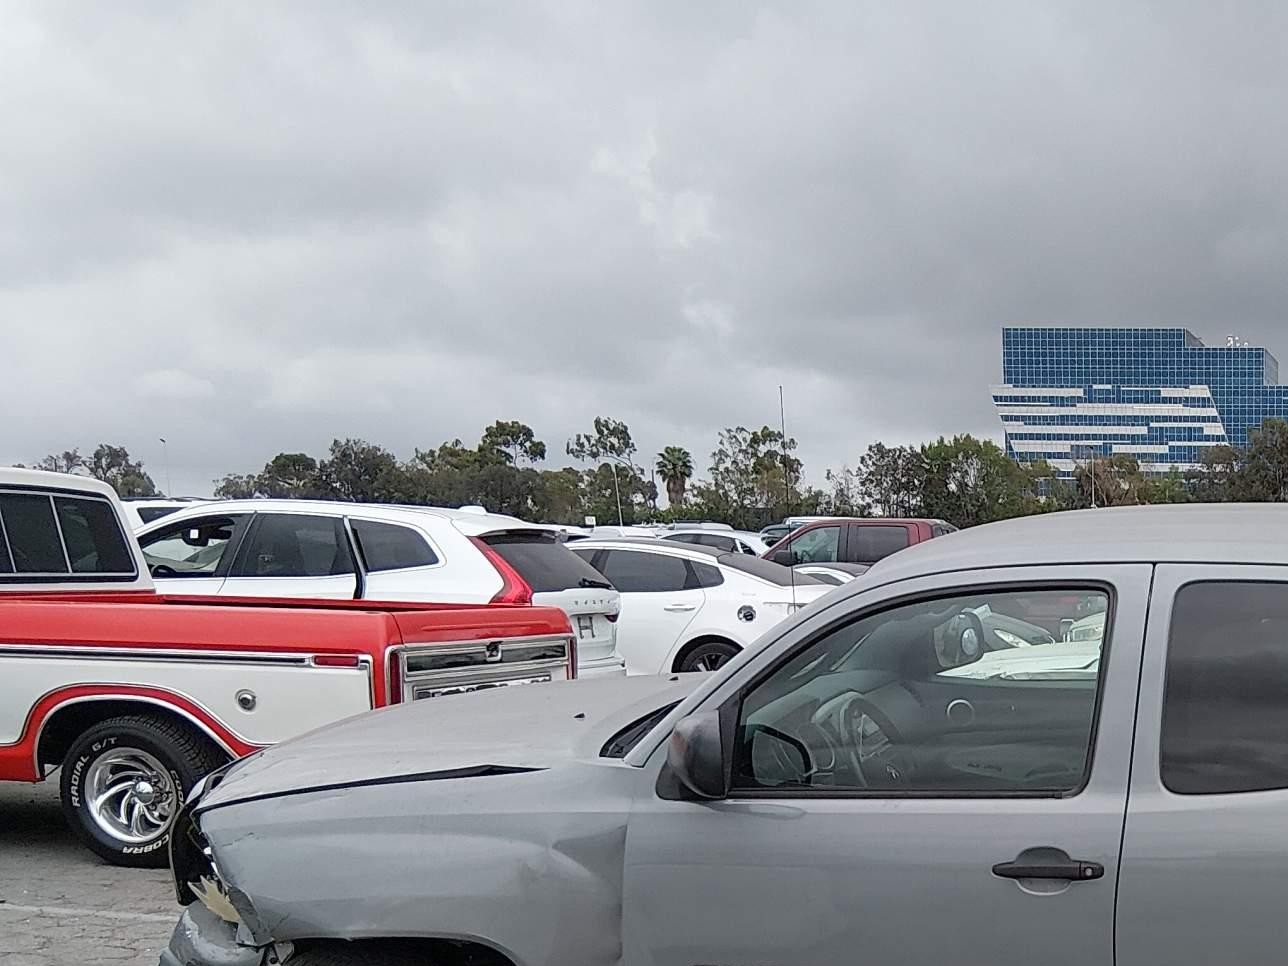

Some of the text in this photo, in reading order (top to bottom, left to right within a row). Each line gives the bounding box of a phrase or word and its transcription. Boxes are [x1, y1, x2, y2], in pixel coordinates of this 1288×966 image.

[92, 737, 118, 752] G/T
[71, 754, 90, 808] RADIAL
[122, 833, 170, 855] COBRA
